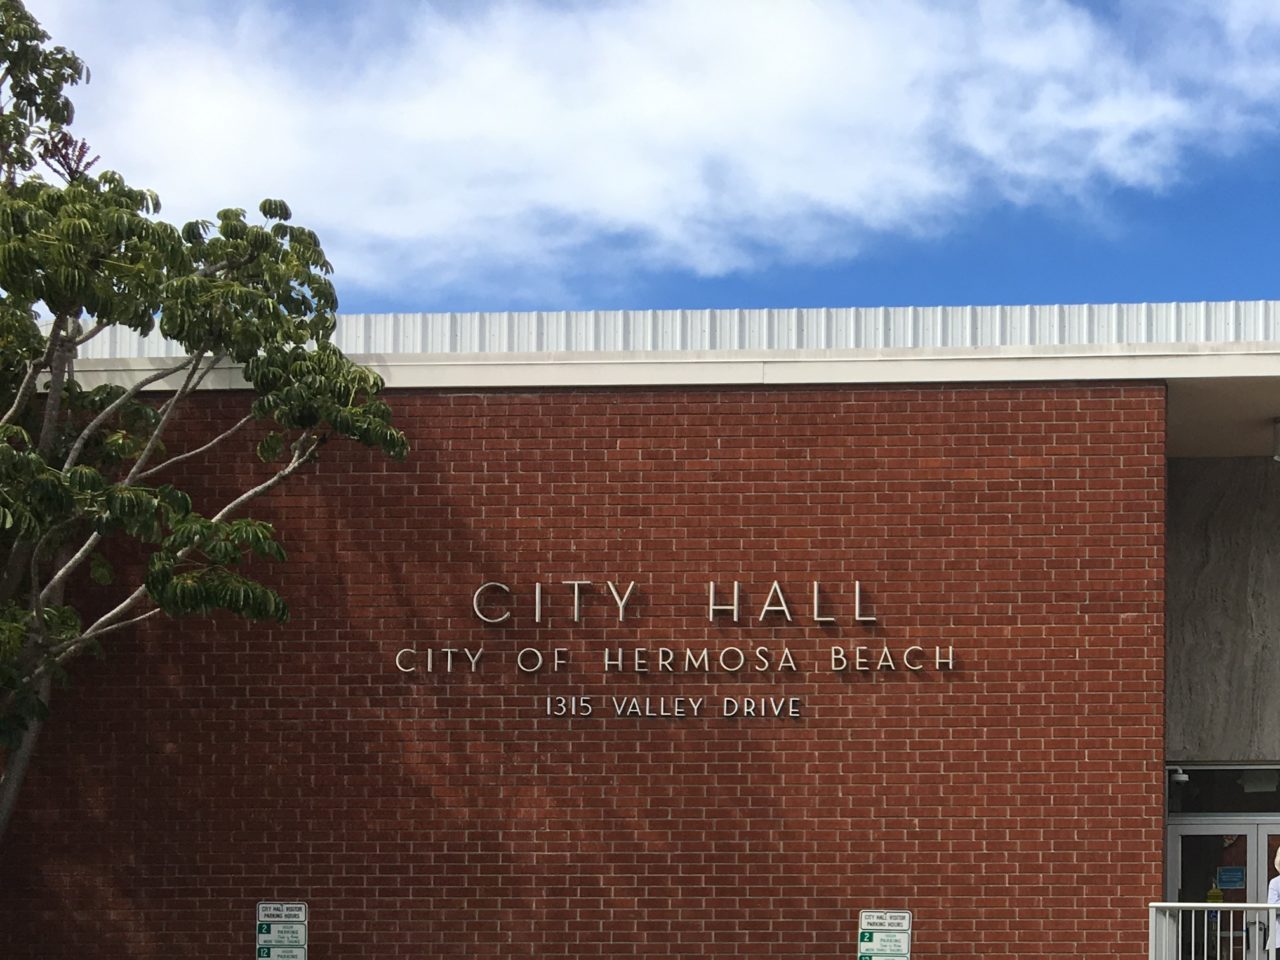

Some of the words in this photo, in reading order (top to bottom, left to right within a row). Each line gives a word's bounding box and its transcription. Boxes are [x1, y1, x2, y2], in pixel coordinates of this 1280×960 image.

[473, 581, 634, 623] CITY
[709, 580, 877, 622] HALL
[395, 648, 483, 672] CITY
[517, 647, 568, 672] OF
[604, 647, 797, 672] HERMOSA
[831, 646, 953, 670] BEACH
[546, 696, 593, 716] 1315
[612, 697, 703, 717] VALLEY
[723, 697, 800, 717] DRIVE
[262, 924, 268, 933] 2
[864, 933, 870, 941] 2
[260, 948, 268, 957] 12
